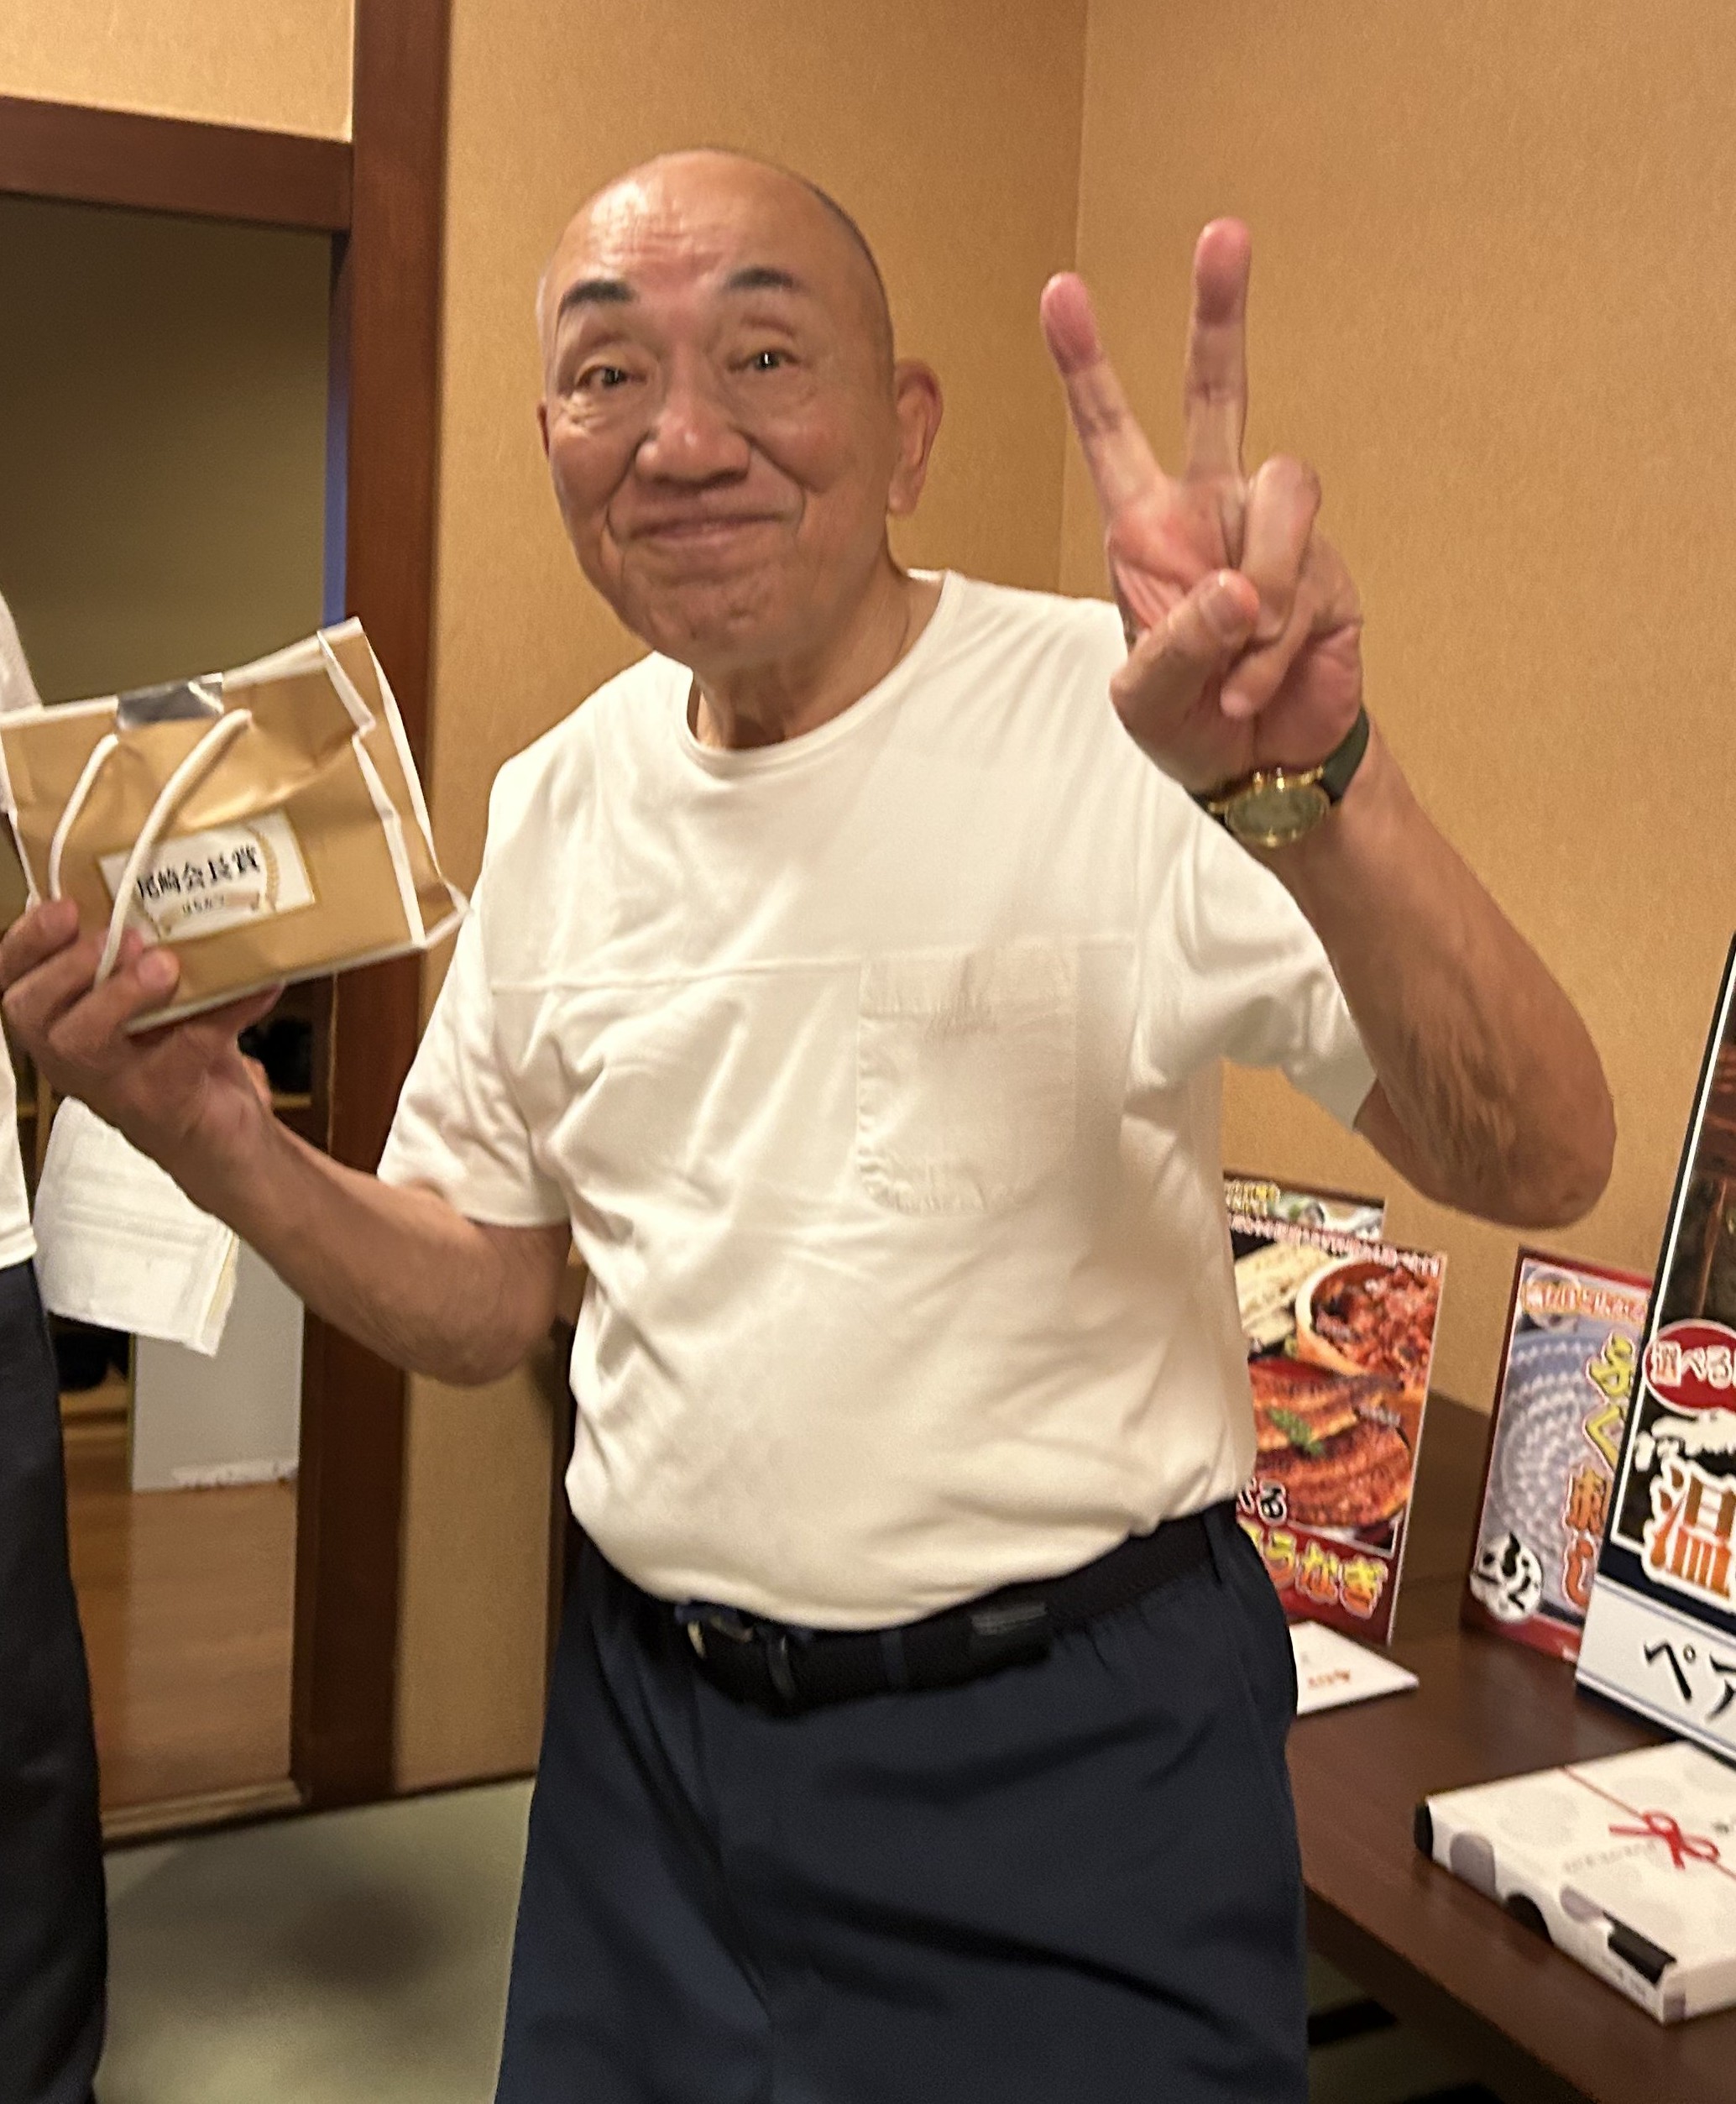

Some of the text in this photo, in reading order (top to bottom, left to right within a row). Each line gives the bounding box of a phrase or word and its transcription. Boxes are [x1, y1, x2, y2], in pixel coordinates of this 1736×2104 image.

[1650, 1340, 1736, 1390] 選べる
[1237, 1516, 1388, 1620] うなぎ
